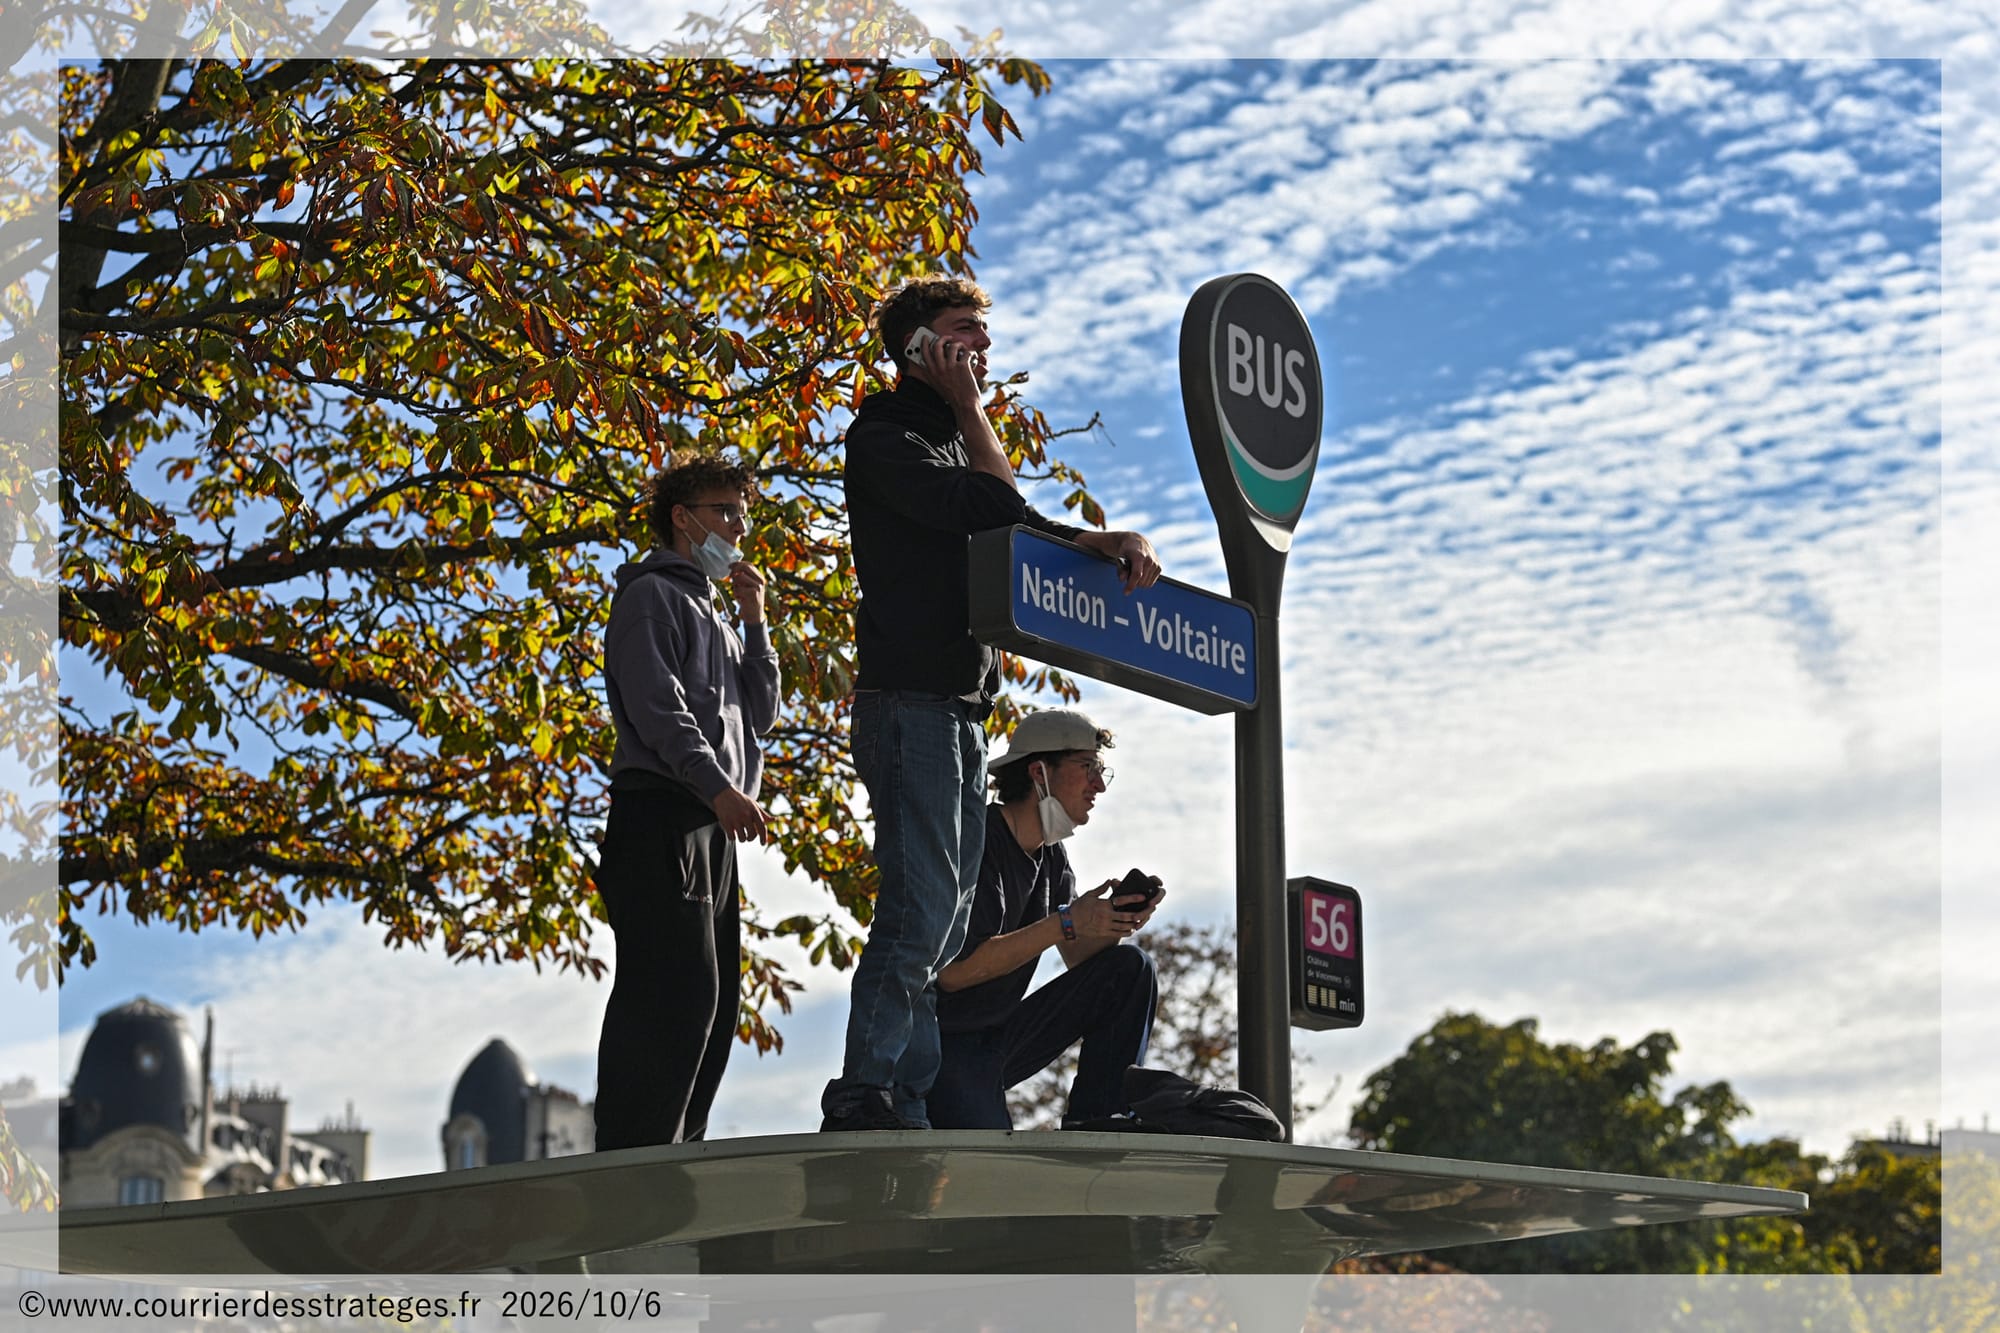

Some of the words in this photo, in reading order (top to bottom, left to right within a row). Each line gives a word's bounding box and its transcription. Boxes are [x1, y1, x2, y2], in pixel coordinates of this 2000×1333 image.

[1228, 323, 1306, 418] BUS
[1022, 562, 1106, 629] Nation
[1136, 602, 1246, 675] Voltaire
[1310, 898, 1348, 952] 56
[1339, 998, 1356, 1013] min
